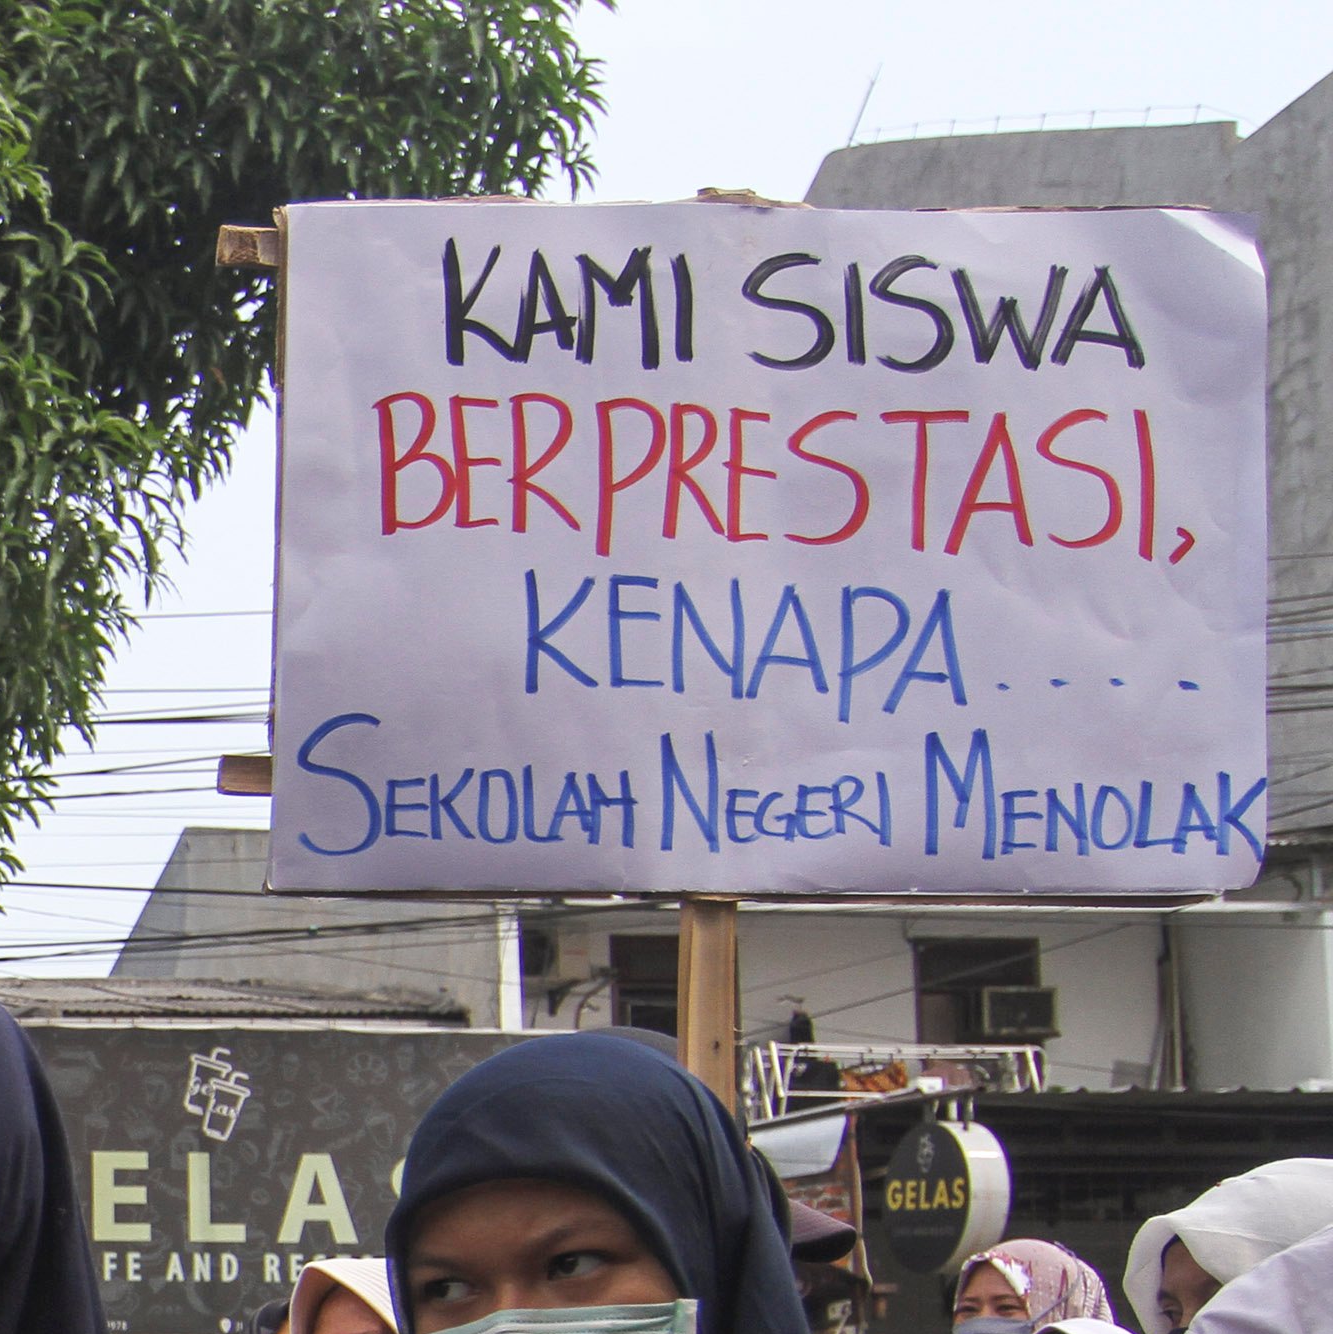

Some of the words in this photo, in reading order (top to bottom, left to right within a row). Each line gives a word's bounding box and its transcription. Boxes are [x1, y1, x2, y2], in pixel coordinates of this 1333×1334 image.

[443, 237, 694, 371] KAMI
[741, 252, 1144, 373] SISWA
[372, 391, 1195, 564] BERPRESTASI,
[297, 713, 637, 856] SEKOLAH
[660, 730, 891, 854] NEGERI
[924, 727, 1268, 861] MENOLAK
[91, 1151, 407, 1246] ELA
[886, 1177, 966, 1211] GELAS
[102, 1252, 143, 1282] FE
[166, 1252, 240, 1283] AND
